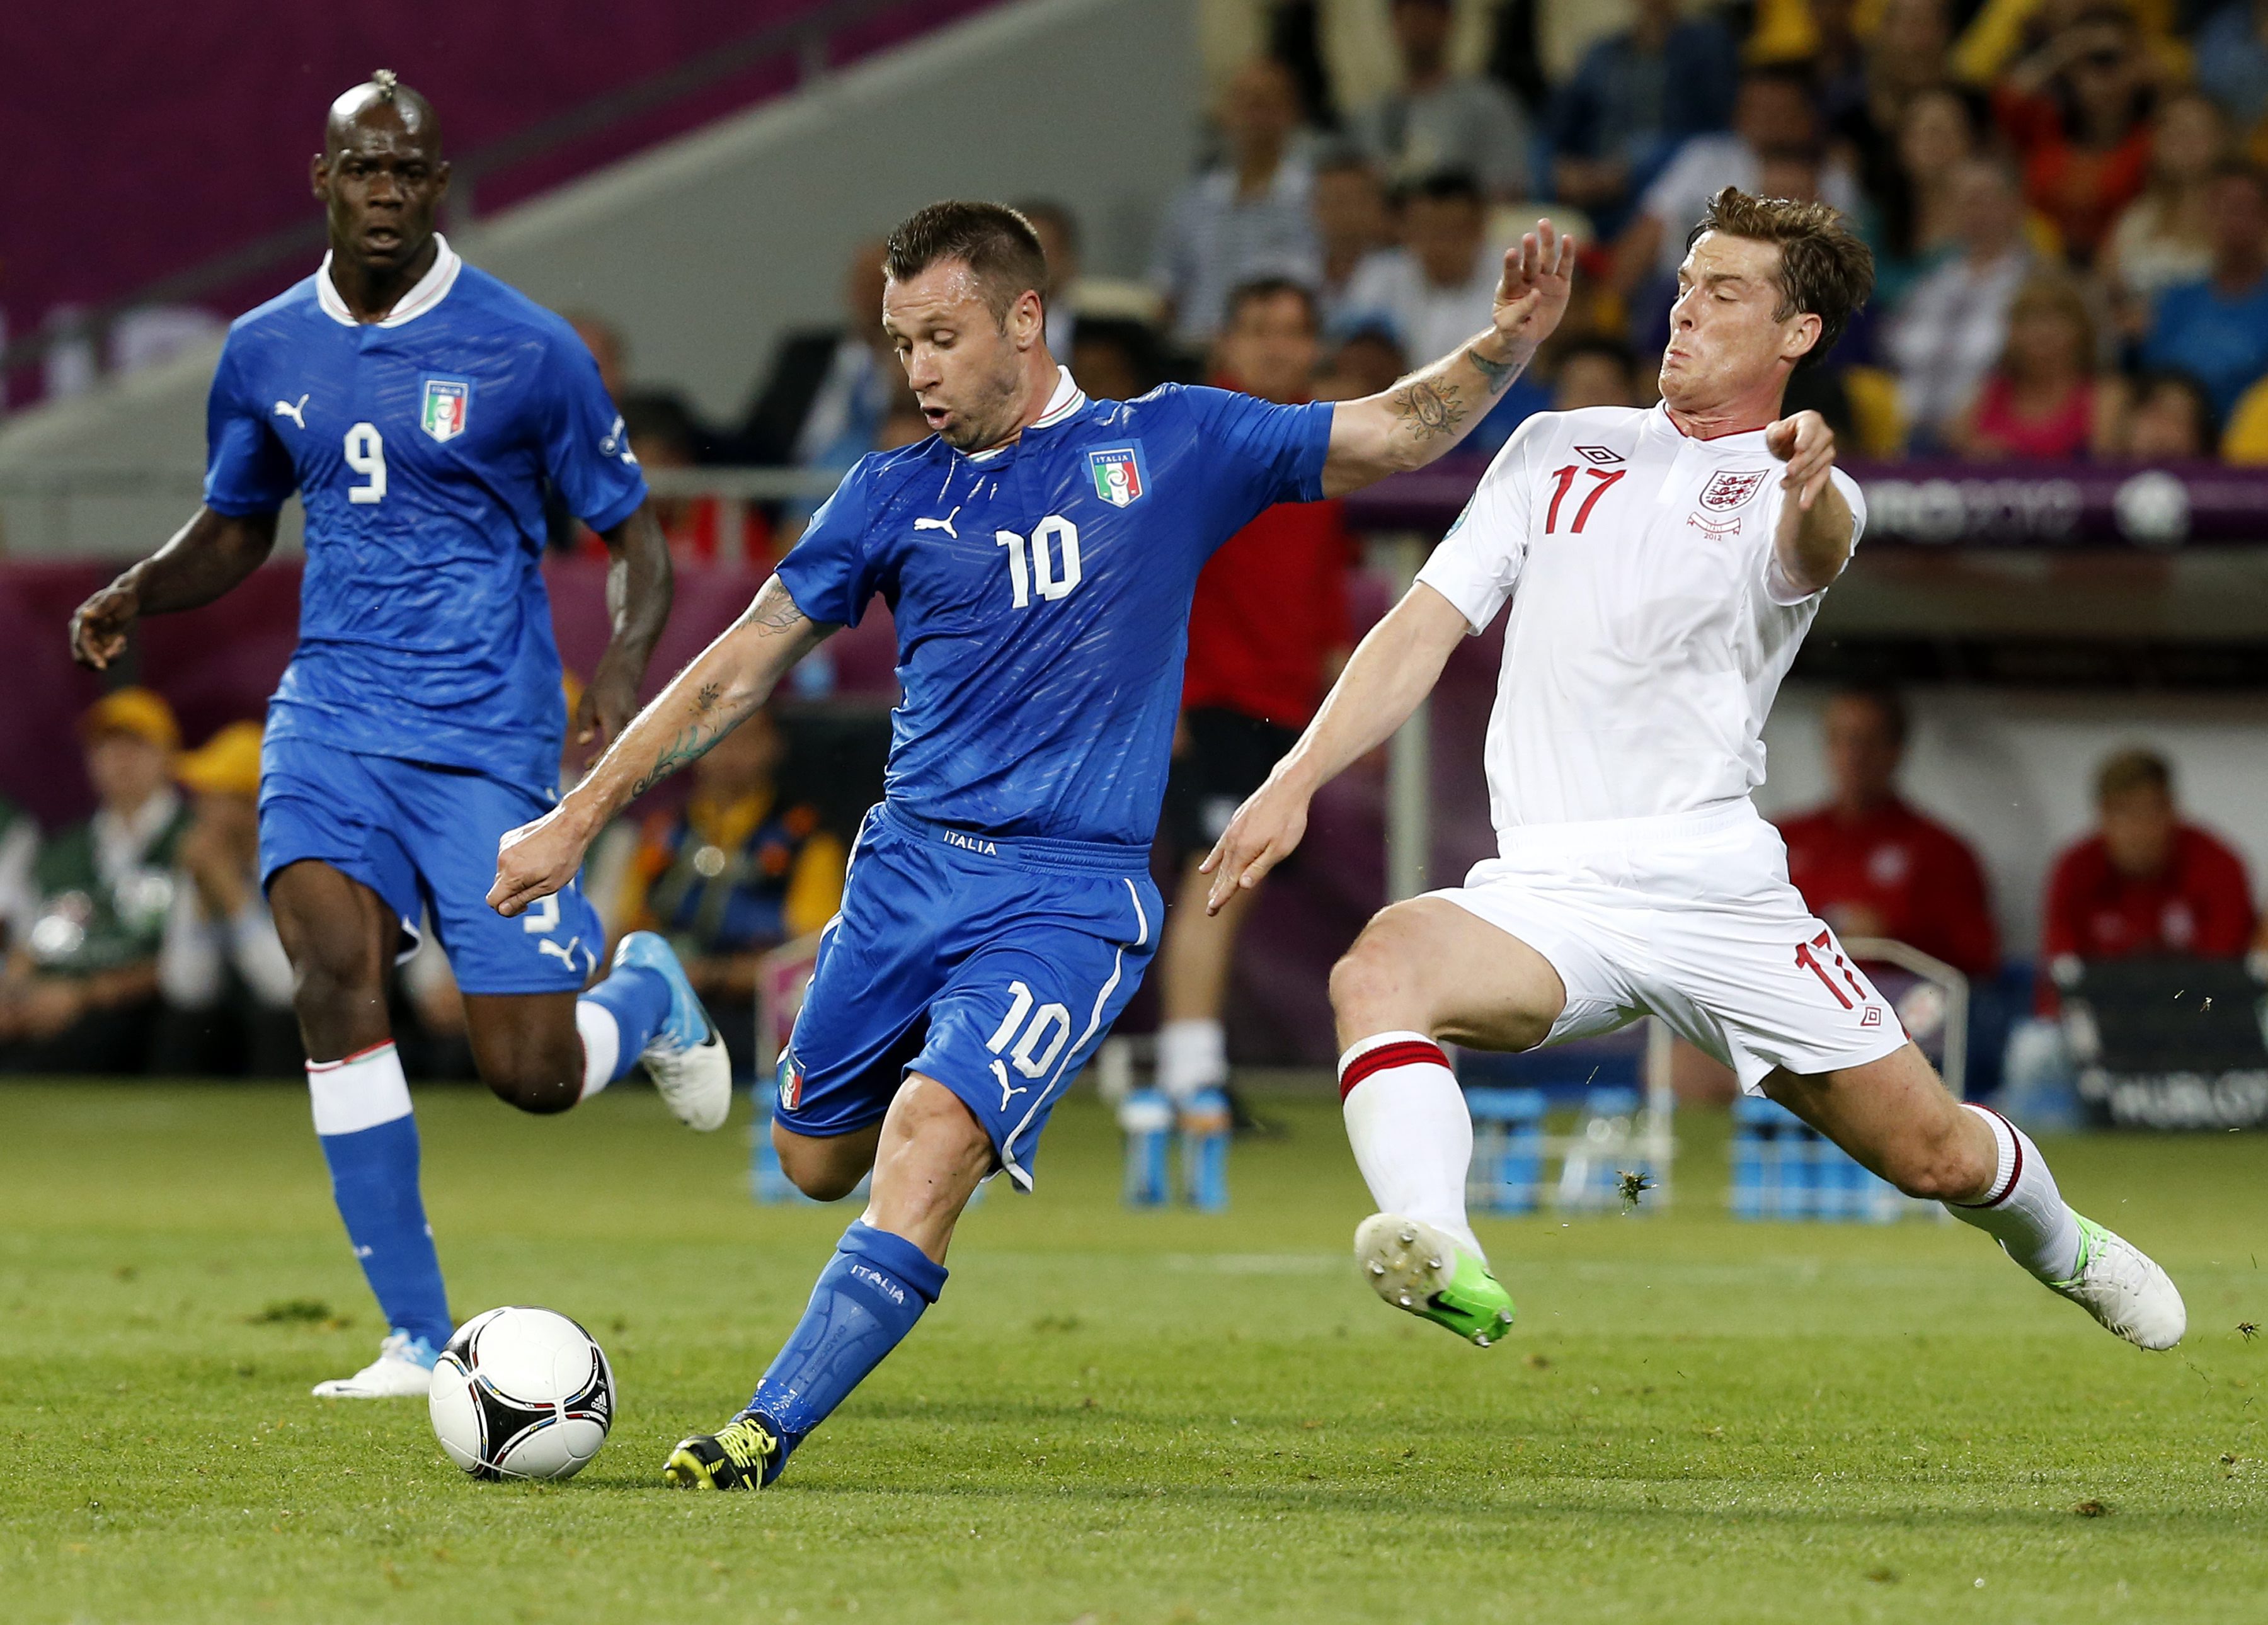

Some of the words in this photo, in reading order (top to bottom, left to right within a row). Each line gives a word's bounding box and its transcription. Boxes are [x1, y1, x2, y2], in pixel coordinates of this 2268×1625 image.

[343, 421, 387, 504] 9
[1096, 454, 1129, 464] ITALIA
[1545, 465, 1628, 534] 17
[995, 514, 1082, 610] 10
[1704, 532, 1722, 542] 2012
[943, 830, 997, 856] ITALIA
[1794, 928, 1867, 1010] 17
[985, 980, 1070, 1079] 10
[850, 1264, 905, 1305] ITALIA
